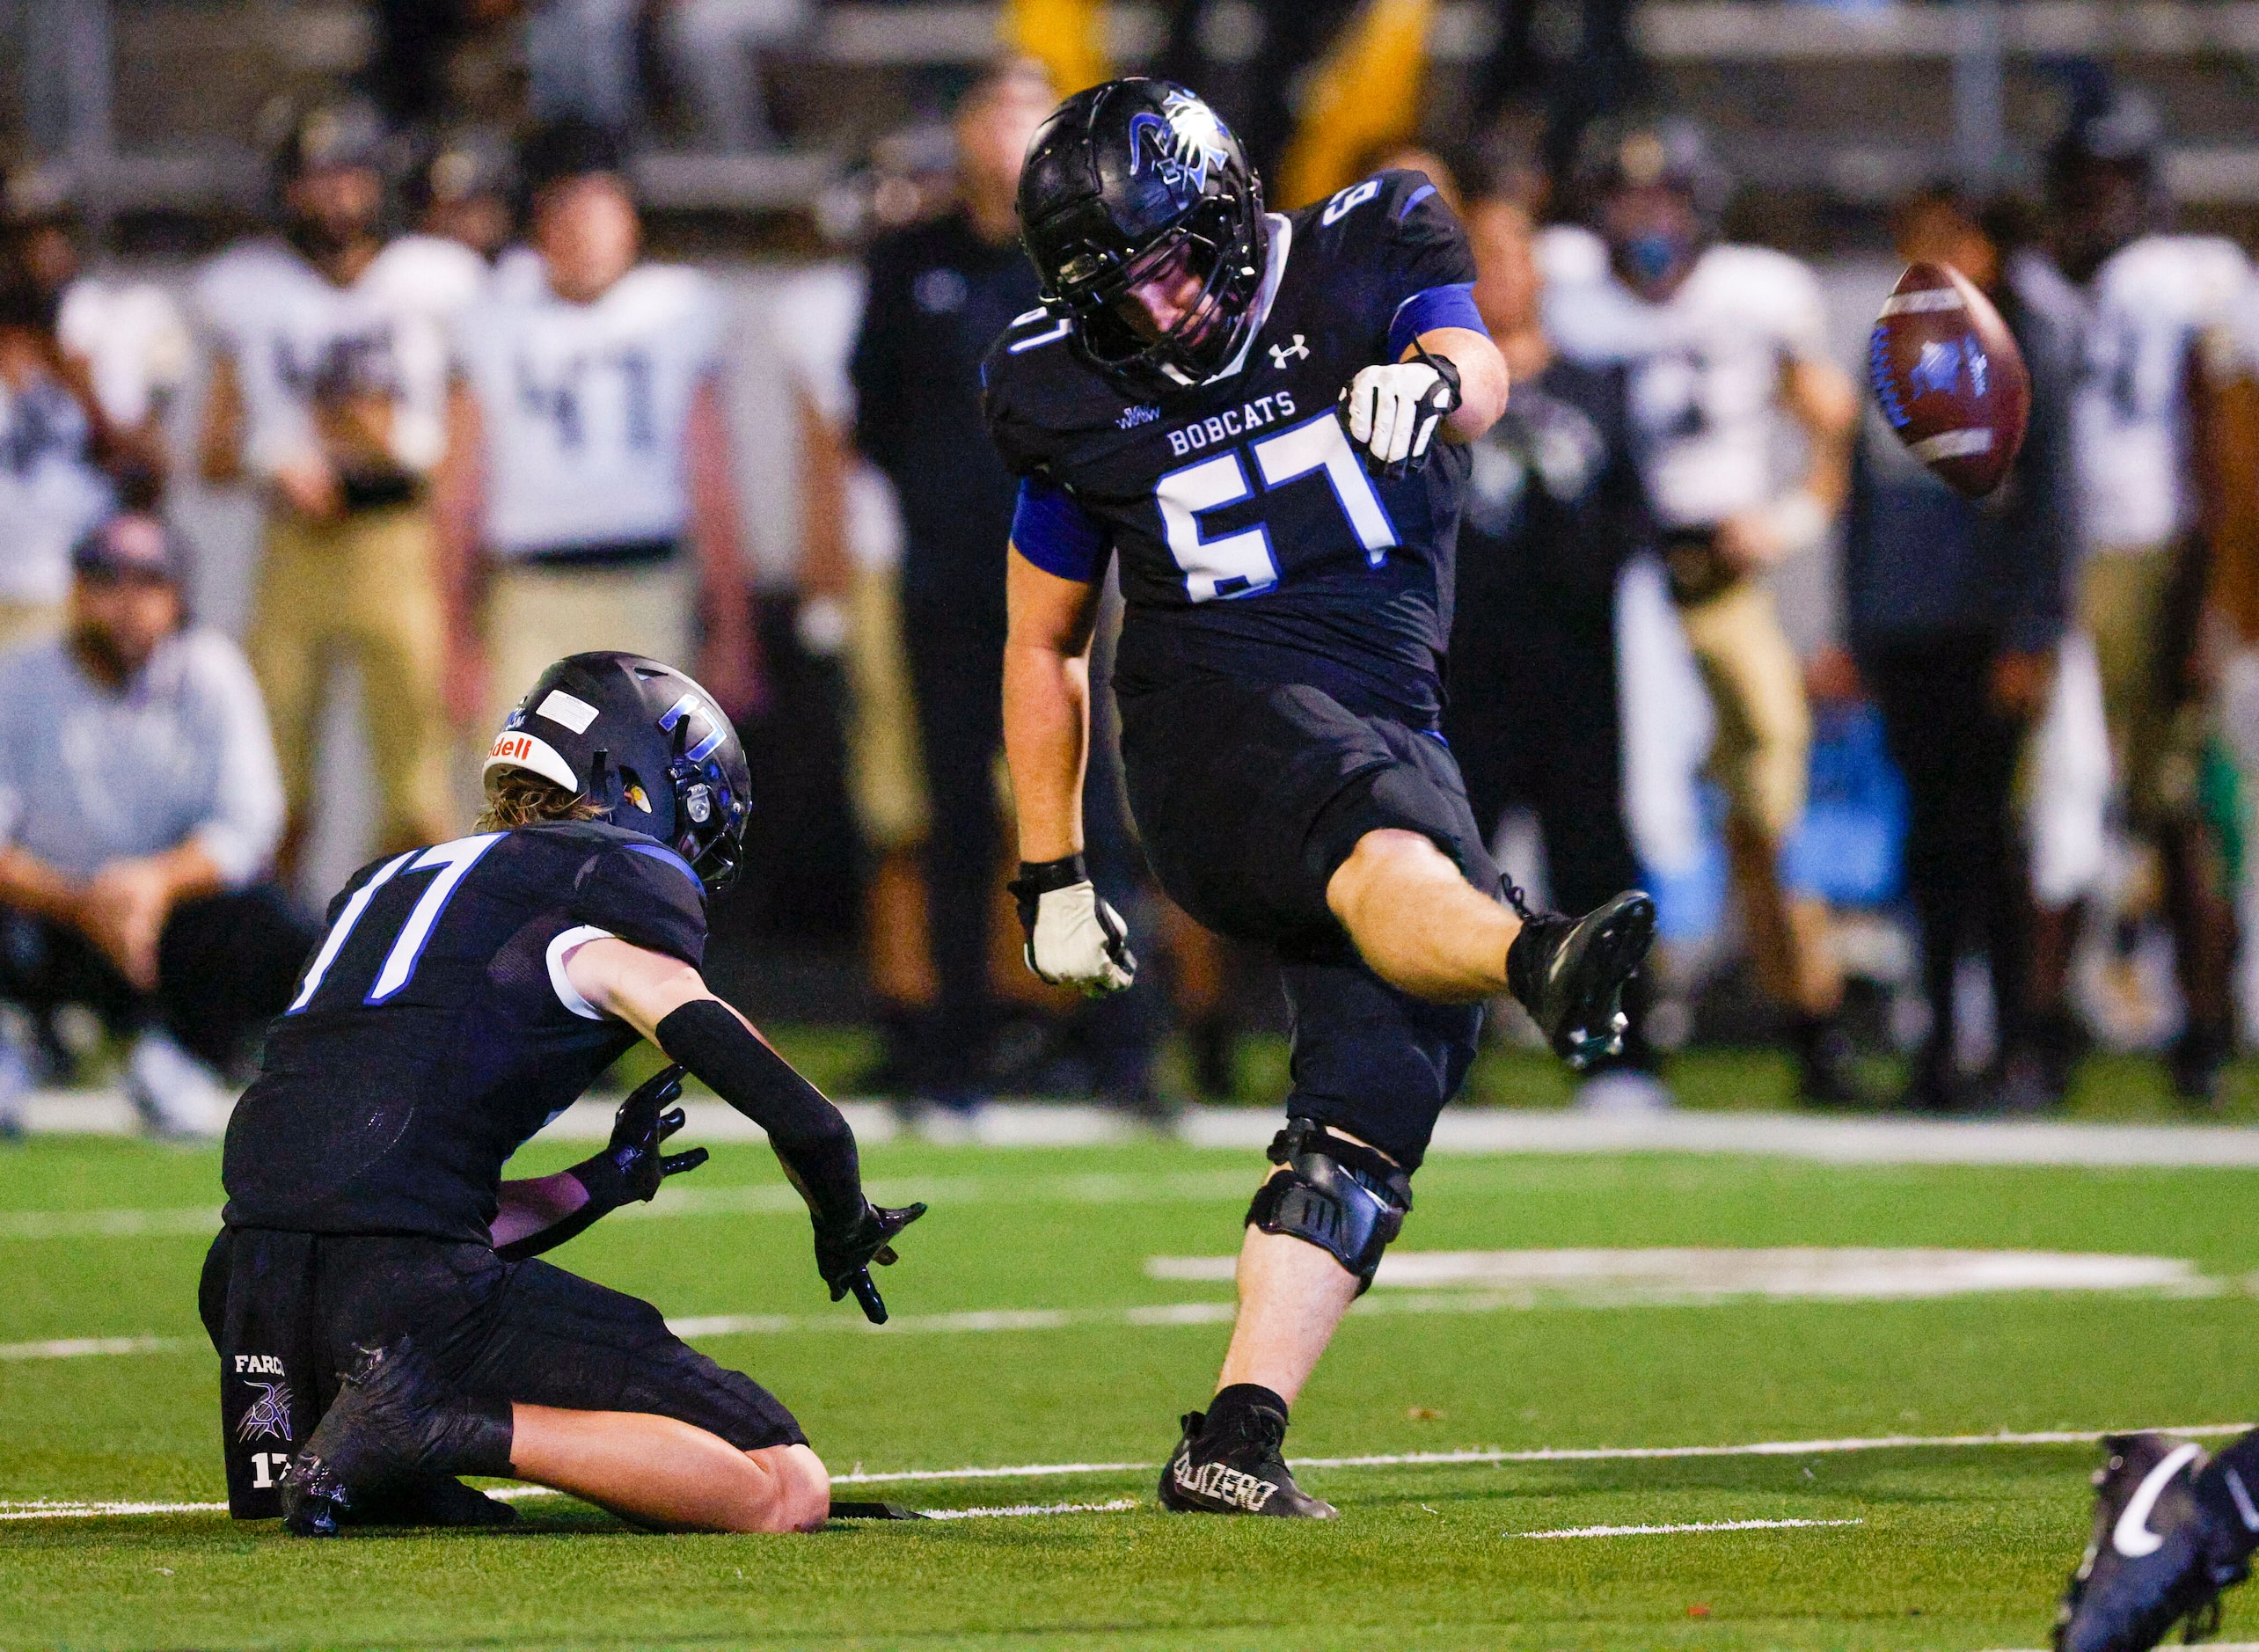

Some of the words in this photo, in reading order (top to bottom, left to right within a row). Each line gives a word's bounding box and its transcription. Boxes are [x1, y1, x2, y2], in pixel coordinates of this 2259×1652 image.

[1166, 391, 1296, 457] BOBCATS
[1151, 405, 1403, 603] 67
[284, 831, 512, 1016] 17
[234, 1355, 286, 1377] FARC
[251, 1452, 293, 1488] 17
